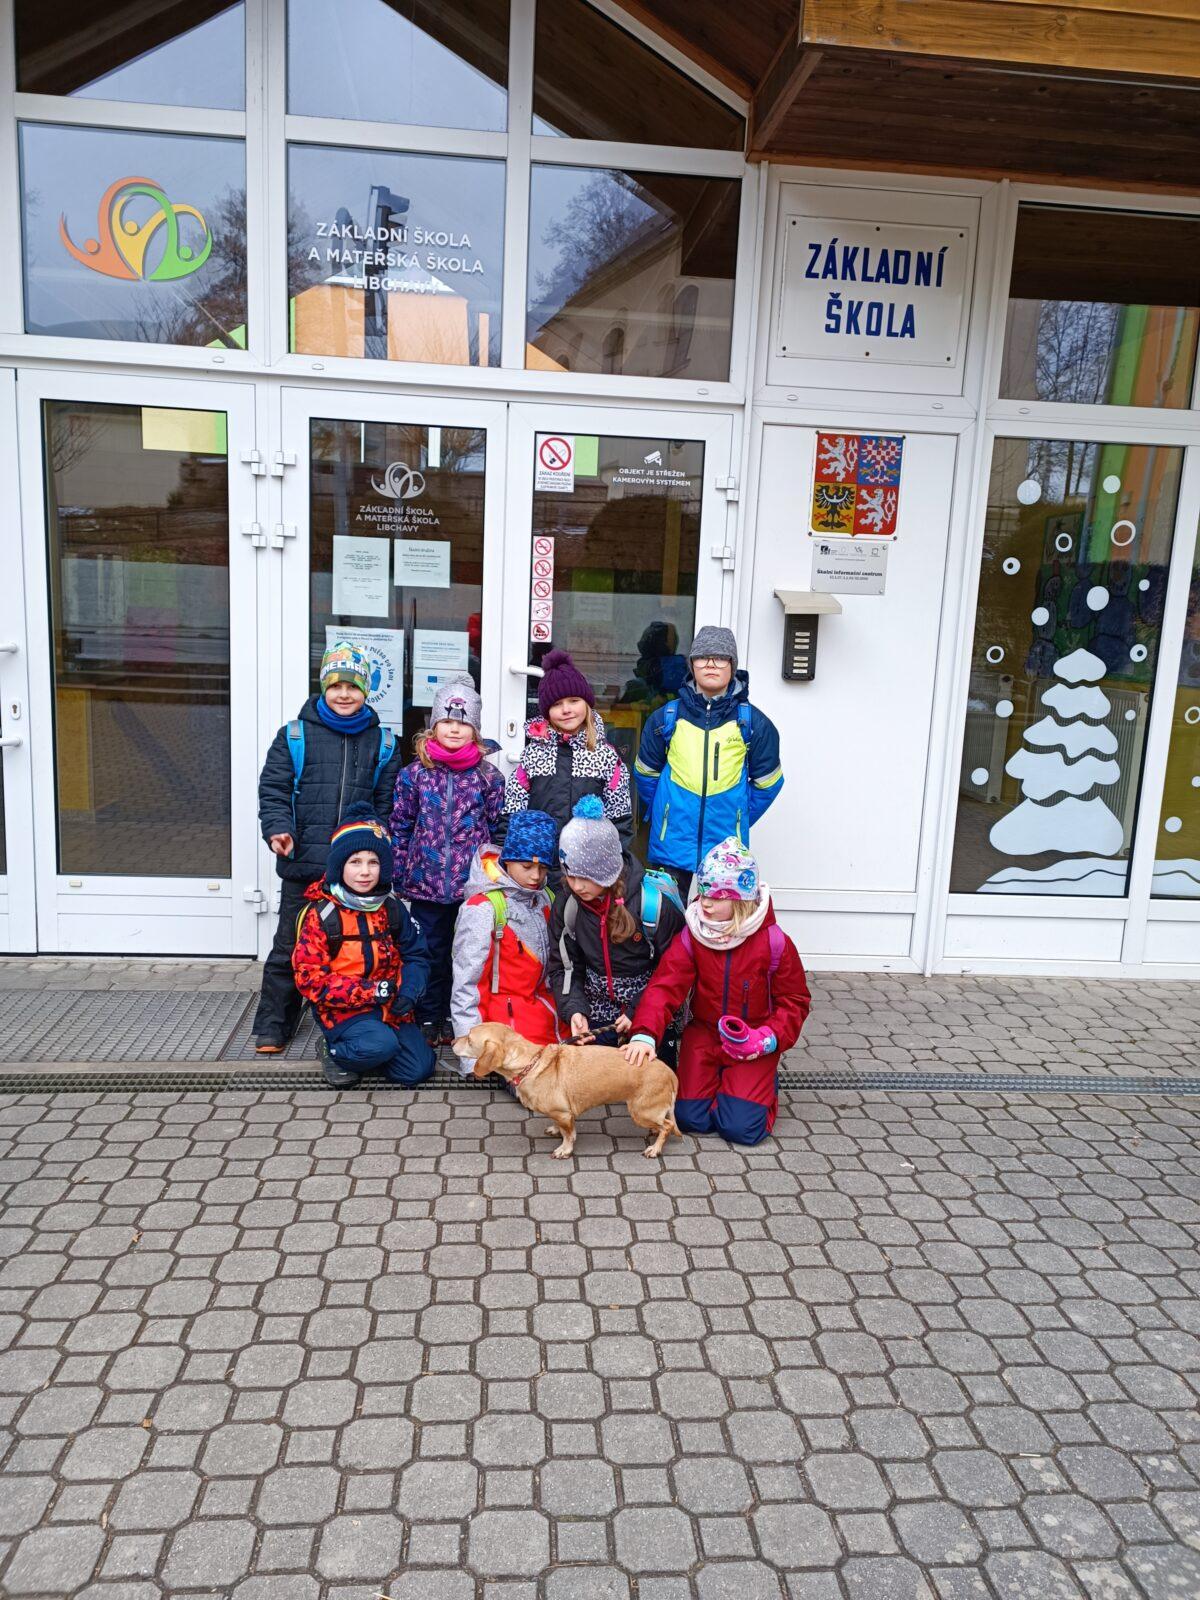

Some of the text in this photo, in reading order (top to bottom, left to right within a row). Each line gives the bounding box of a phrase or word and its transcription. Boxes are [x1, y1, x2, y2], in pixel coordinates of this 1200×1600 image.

[316, 220, 472, 248] ZÁKLADNÍ ŠKOLA
[308, 247, 484, 274] A MATEŘSKÁ ŠKOLA
[805, 238, 949, 288] ZÁKLADNÍ
[353, 275, 439, 295] LIBCHAVY
[825, 292, 915, 338] ŠKOLA
[618, 467, 645, 475] OBJEKT
[656, 469, 686, 477] STŘEŽEN
[612, 476, 691, 487] KAMEROVÝM SYSTÉMEM
[360, 504, 434, 516] ZÁKLADNÍ ŠKOLA
[355, 513, 440, 525] A MATEŘSKÁ ŠKOLA
[377, 523, 419, 533] LIBCHAVY
